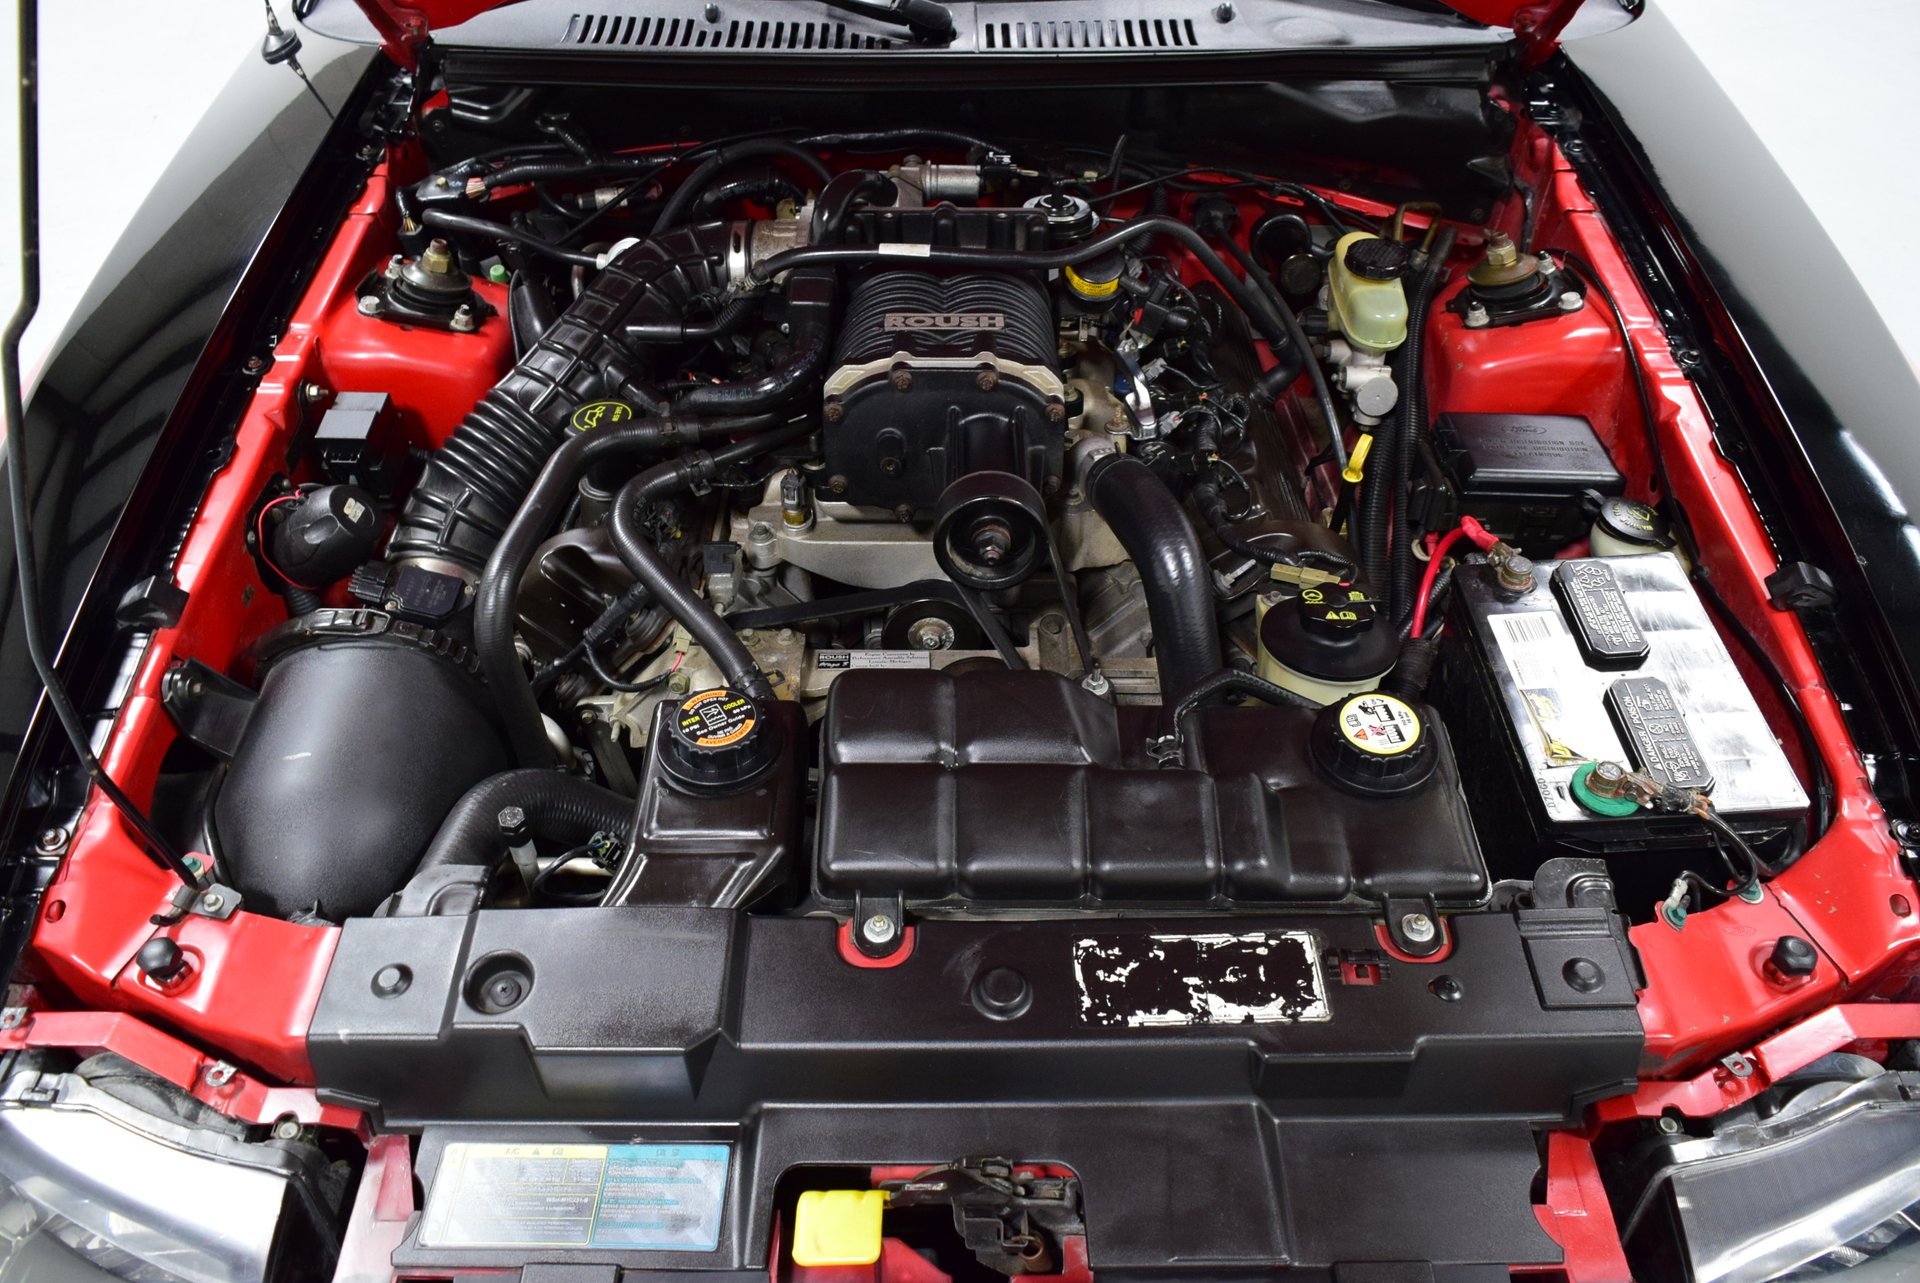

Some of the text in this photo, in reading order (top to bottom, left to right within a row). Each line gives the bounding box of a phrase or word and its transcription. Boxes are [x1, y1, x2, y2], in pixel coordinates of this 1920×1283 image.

[884, 315, 1004, 328] ROUSH
[681, 698, 746, 726] INTER COOLER
[1622, 696, 1641, 724] POISON
[689, 723, 700, 731] PSI
[696, 714, 746, 736] See Owner Guide
[1638, 731, 1660, 762] DANGER
[504, 1147, 520, 1156] A/C
